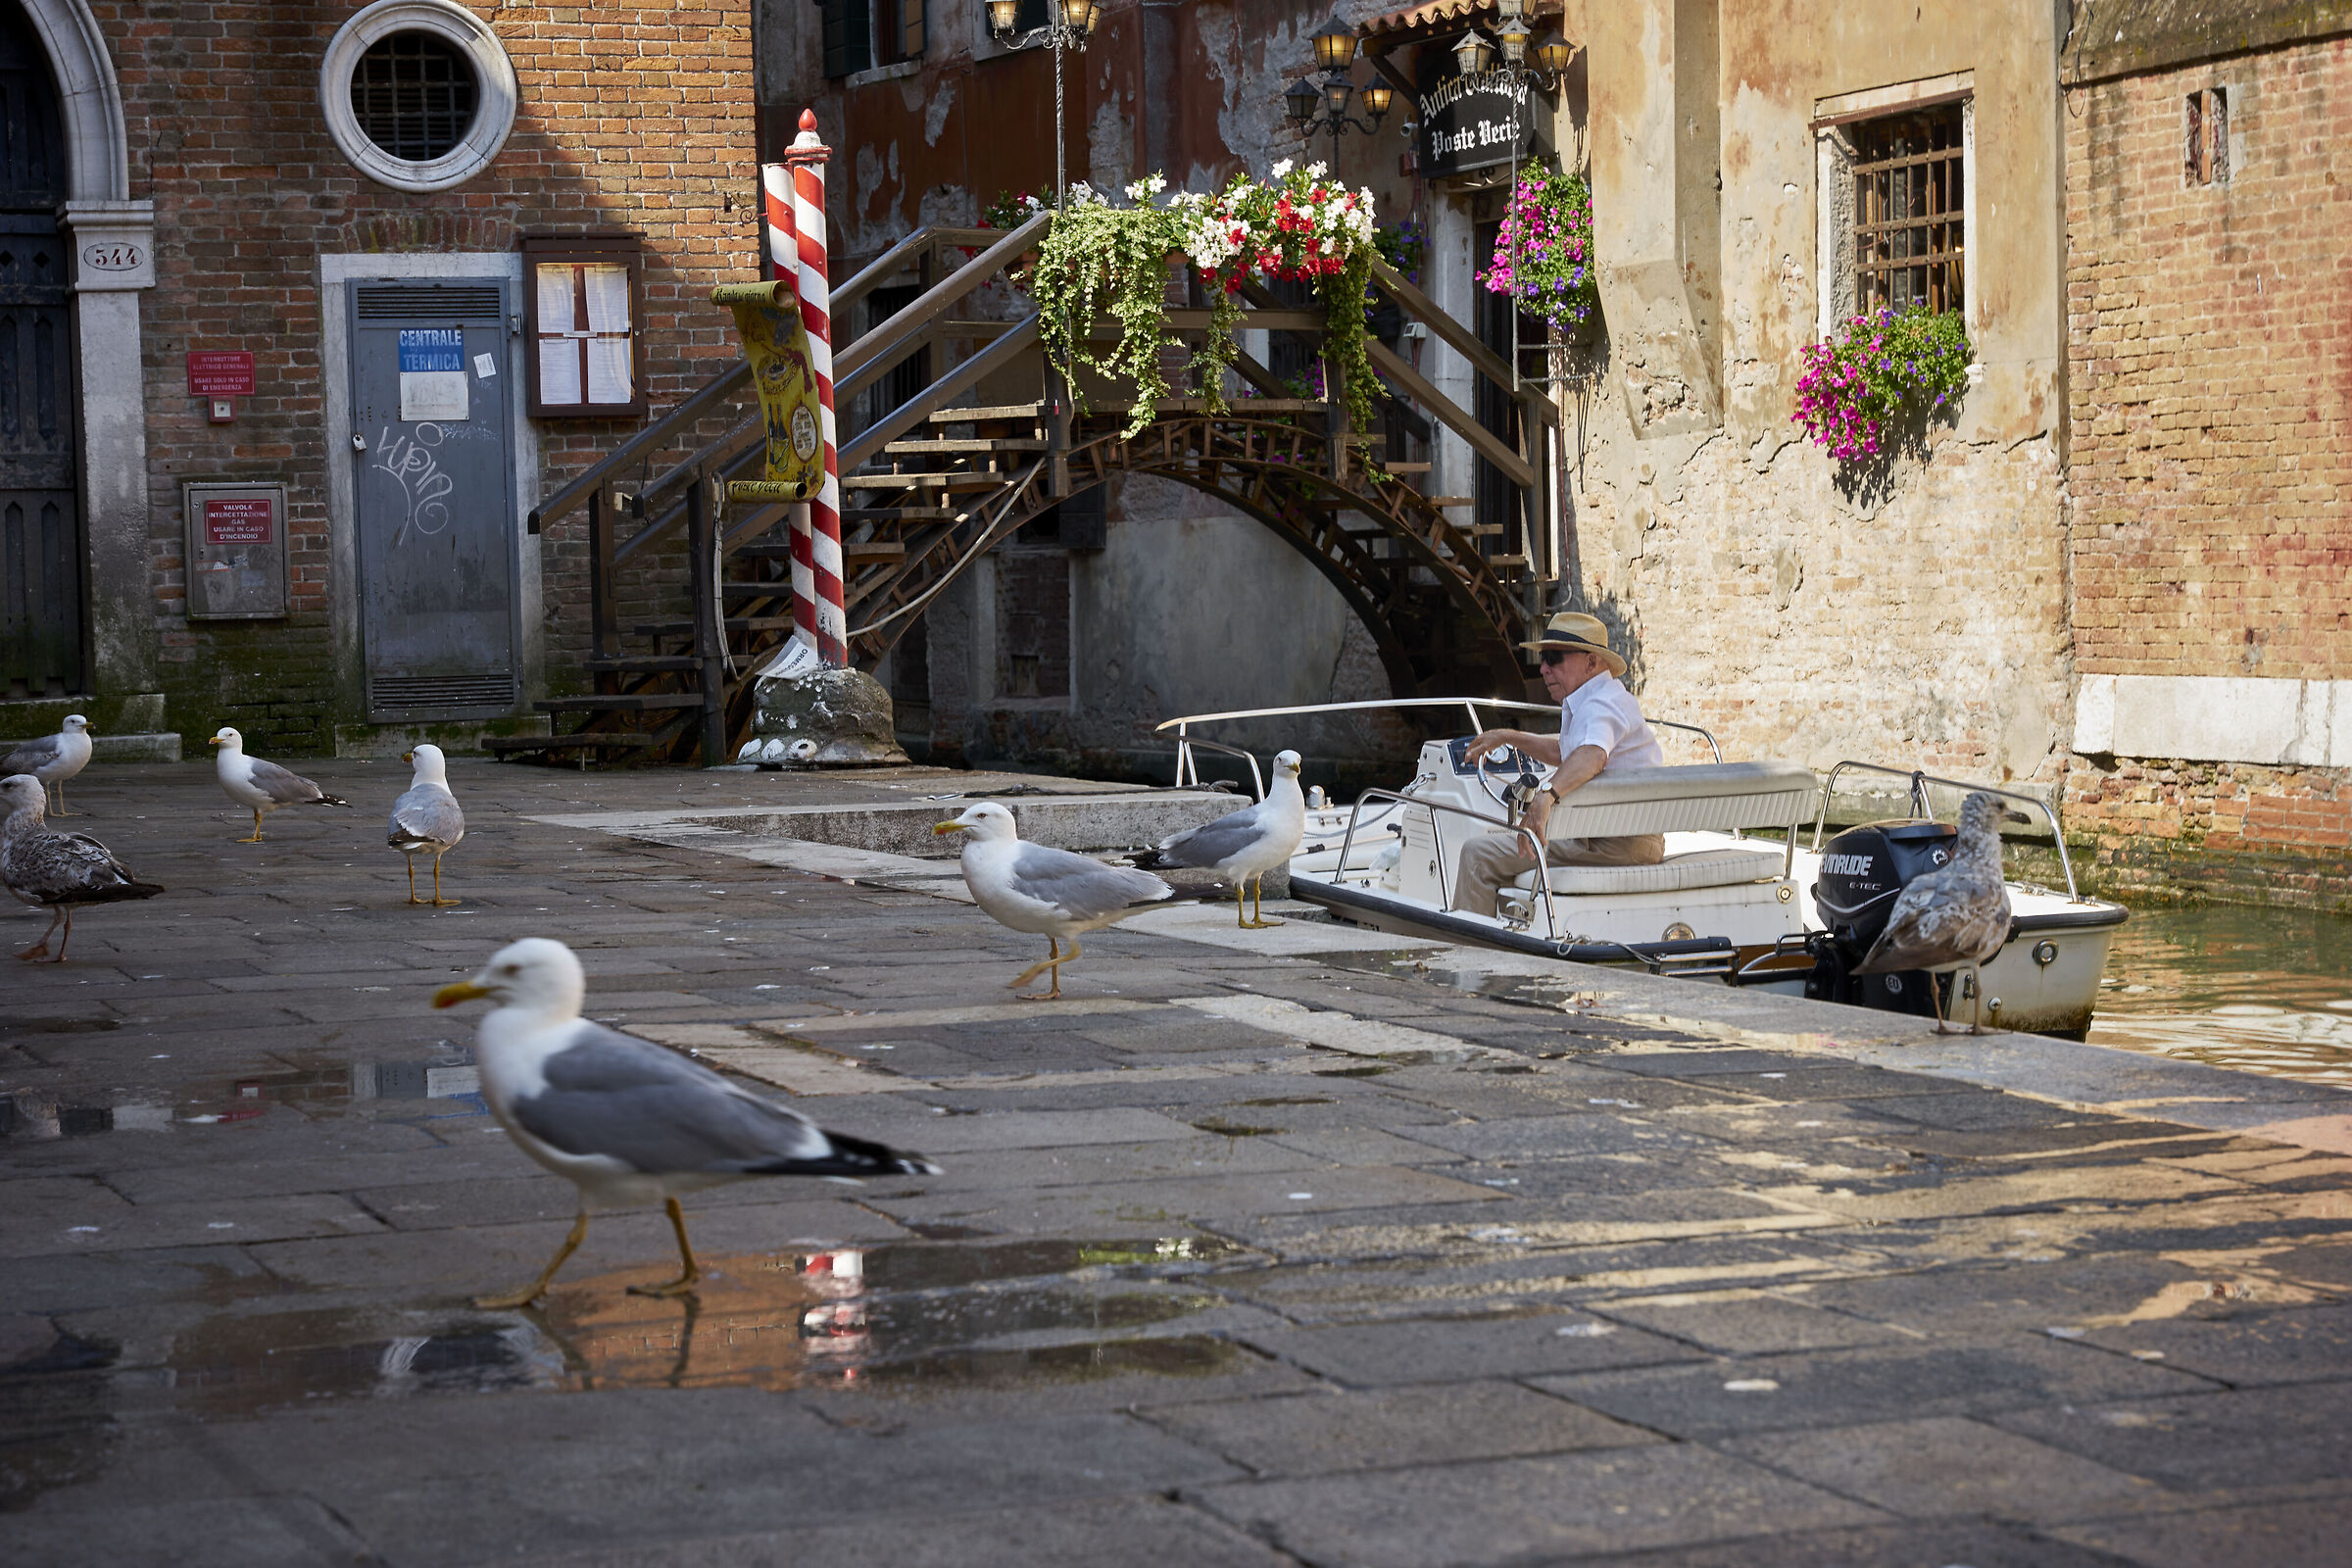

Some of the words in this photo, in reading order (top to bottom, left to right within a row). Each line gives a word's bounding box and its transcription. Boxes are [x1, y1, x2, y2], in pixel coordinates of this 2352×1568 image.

[1419, 75, 1462, 128] Antica
[1432, 126, 1476, 161] Poste
[95, 248, 136, 266] 544
[400, 329, 462, 346] CENTRALE
[403, 353, 460, 370] TERMICA
[1849, 881, 1882, 891] E-TEC
